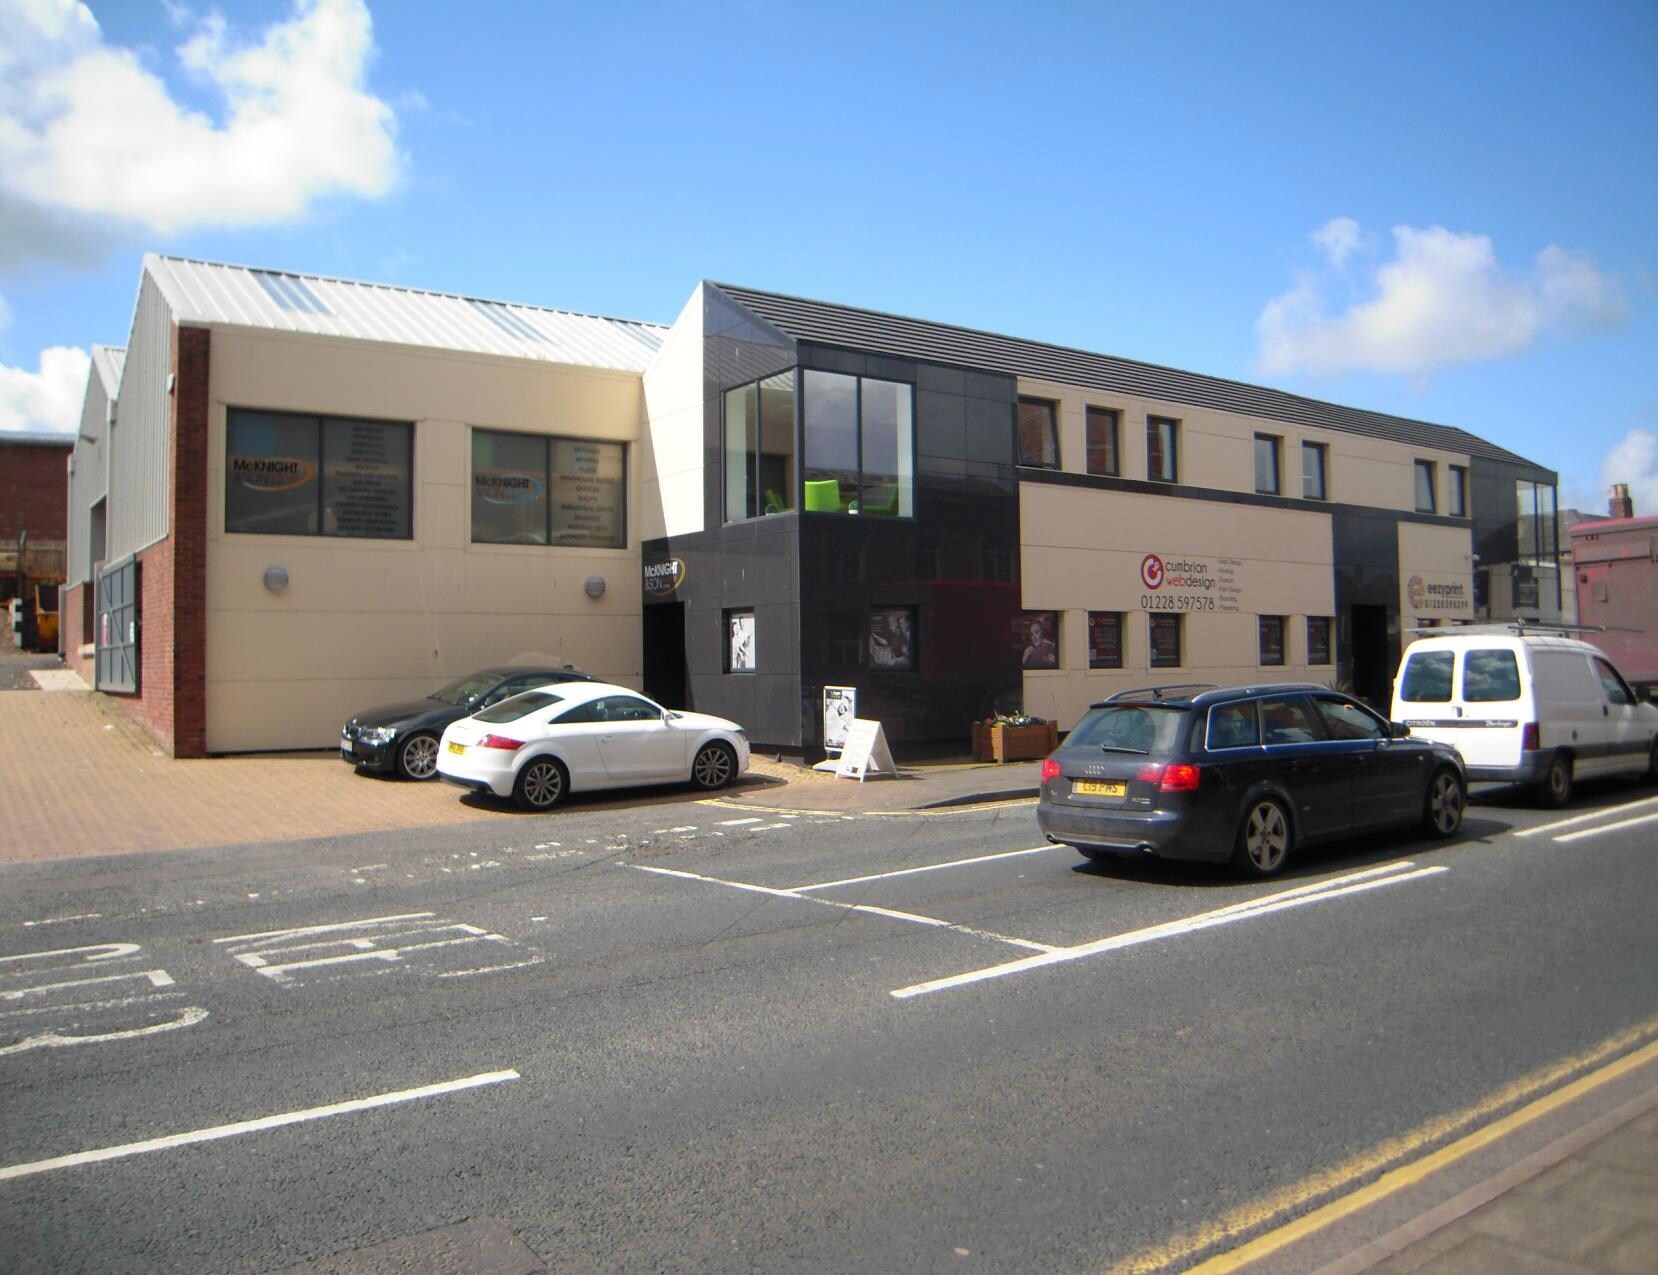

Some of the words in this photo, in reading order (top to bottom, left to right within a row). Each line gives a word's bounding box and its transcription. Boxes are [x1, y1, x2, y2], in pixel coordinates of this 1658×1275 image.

[233, 459, 298, 474] McKNIGHT
[1165, 560, 1208, 574] cumbrian
[1165, 574, 1216, 590] webdesign
[1140, 595, 1175, 610] 01228
[1177, 596, 1215, 611] 597578
